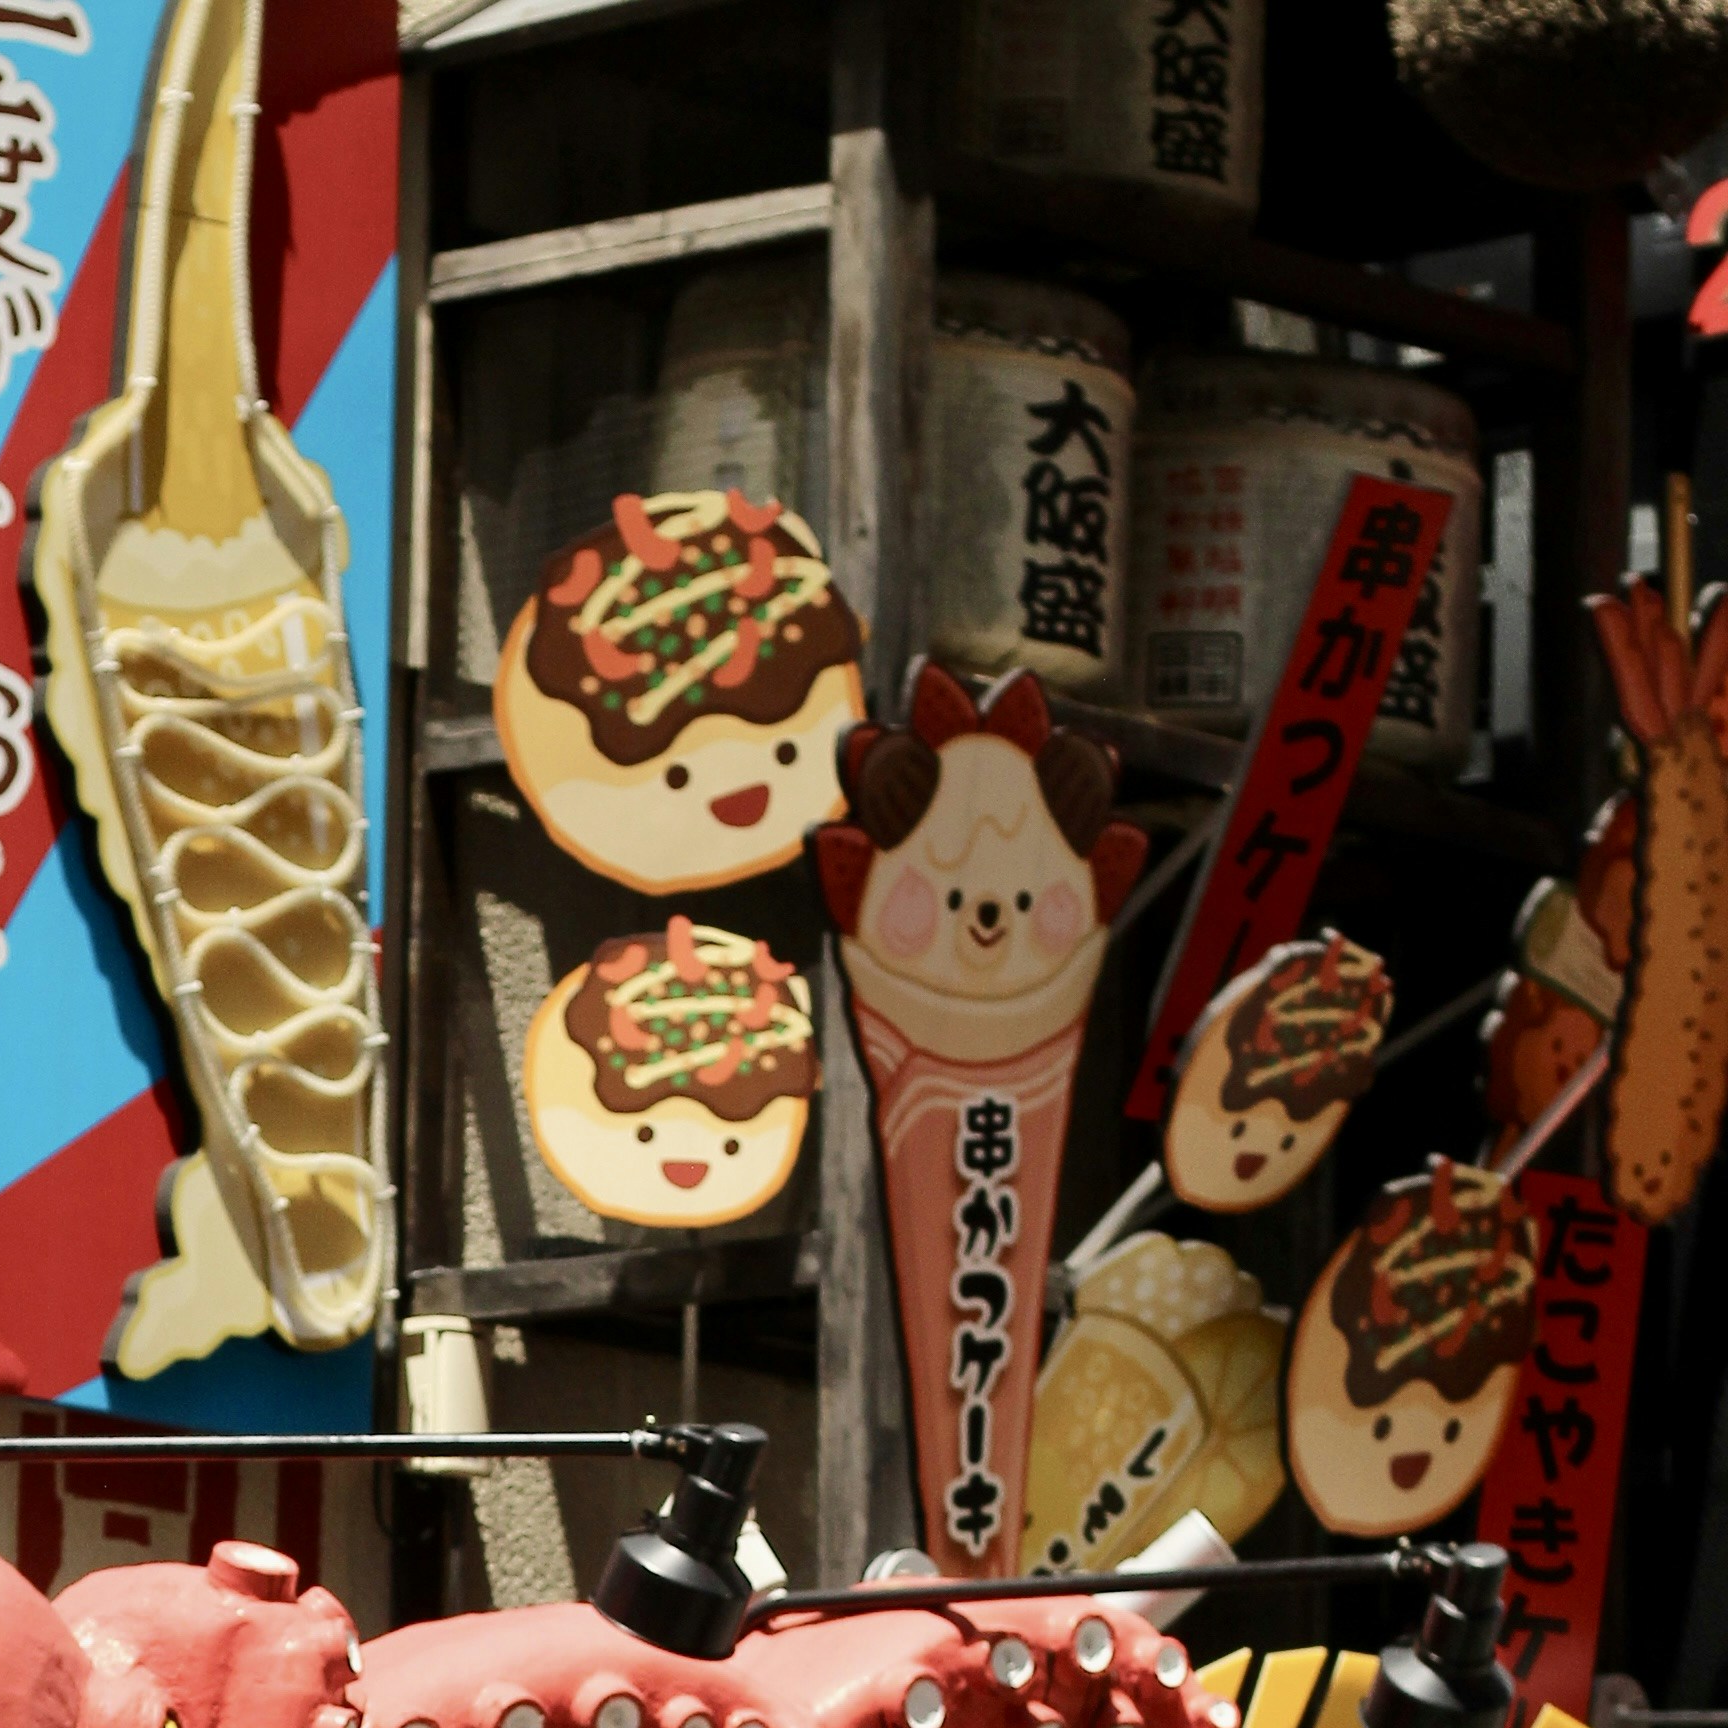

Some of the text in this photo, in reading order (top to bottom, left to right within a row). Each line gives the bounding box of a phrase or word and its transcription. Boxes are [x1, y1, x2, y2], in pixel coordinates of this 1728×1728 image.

[1156, 505, 1423, 1083] 串かつケー
[952, 1099, 1018, 1547] 串かつケーキ
